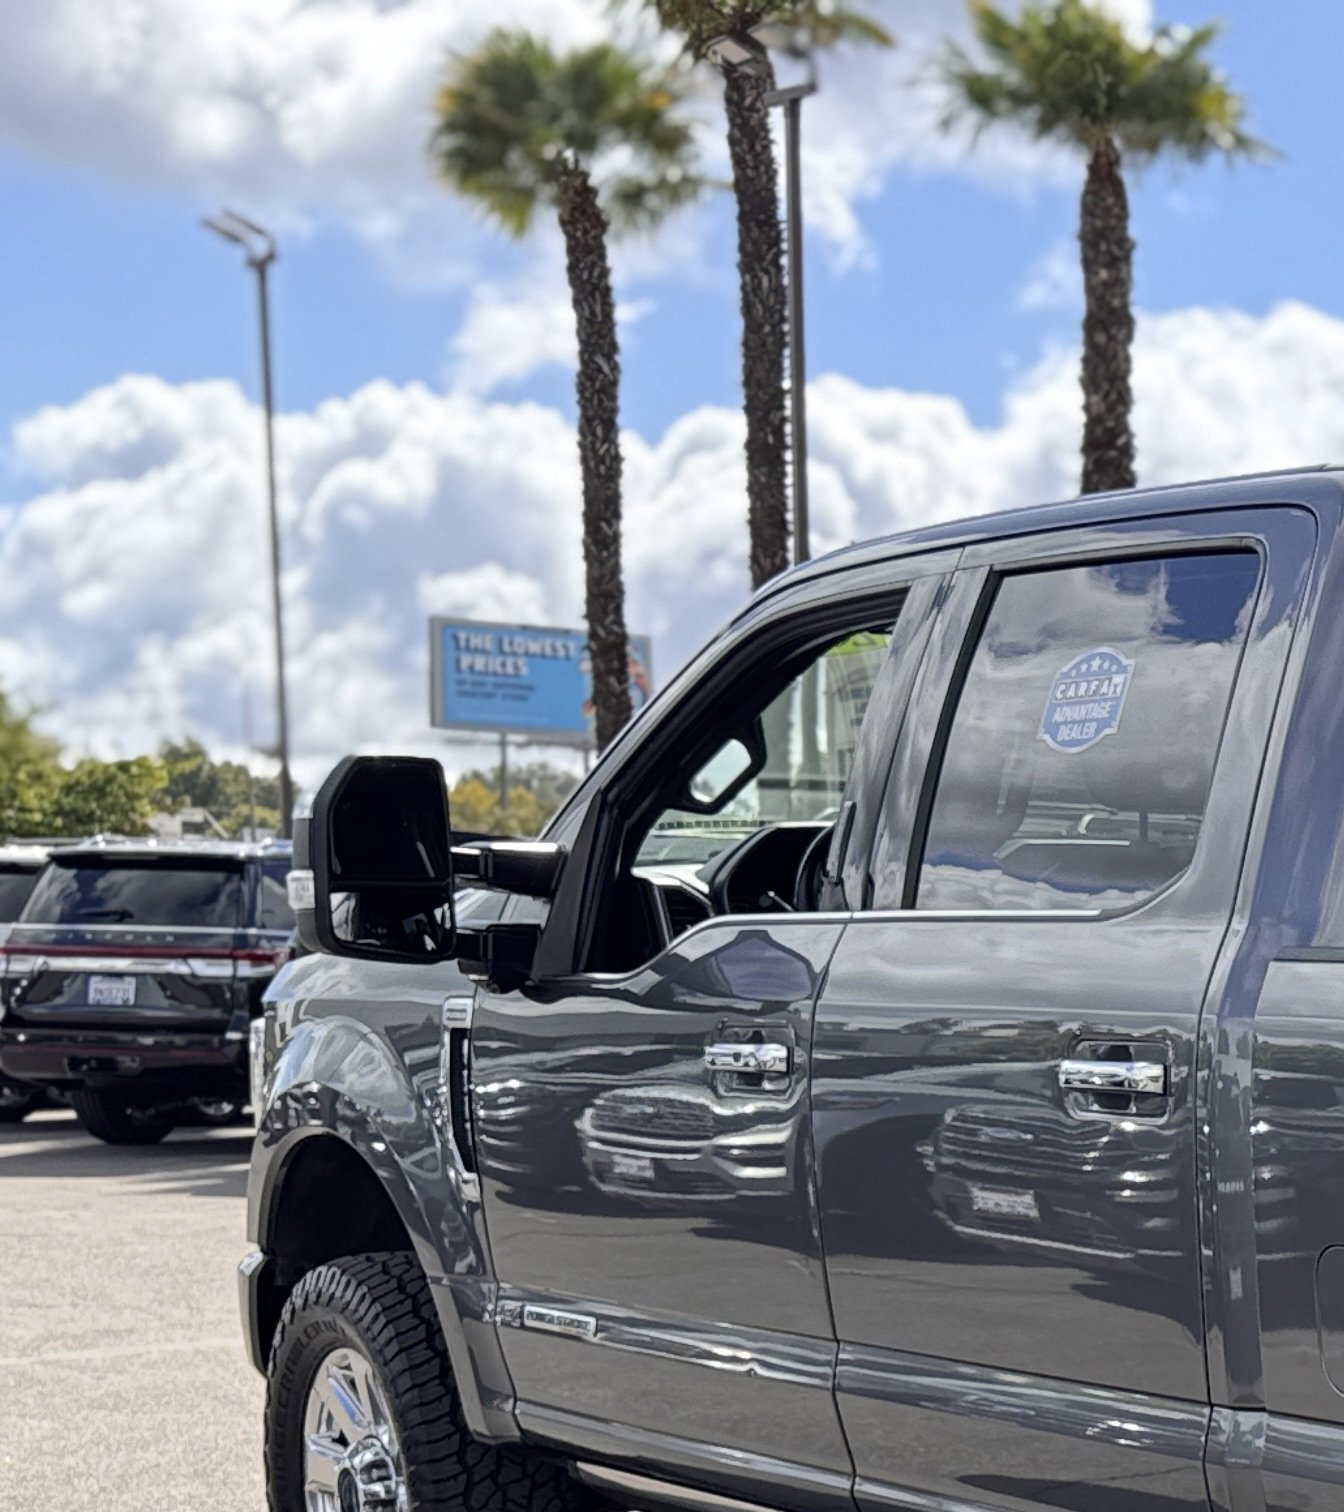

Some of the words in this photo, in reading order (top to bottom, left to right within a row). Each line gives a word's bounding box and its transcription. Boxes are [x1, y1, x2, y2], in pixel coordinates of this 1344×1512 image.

[454, 631, 492, 651] THE
[501, 635, 577, 659] LOWEST
[456, 655, 529, 677] PRICES
[1055, 675, 1125, 700] CARFAX
[1052, 702, 1113, 723] ADVANTAGE
[1057, 722, 1097, 742] DEALER
